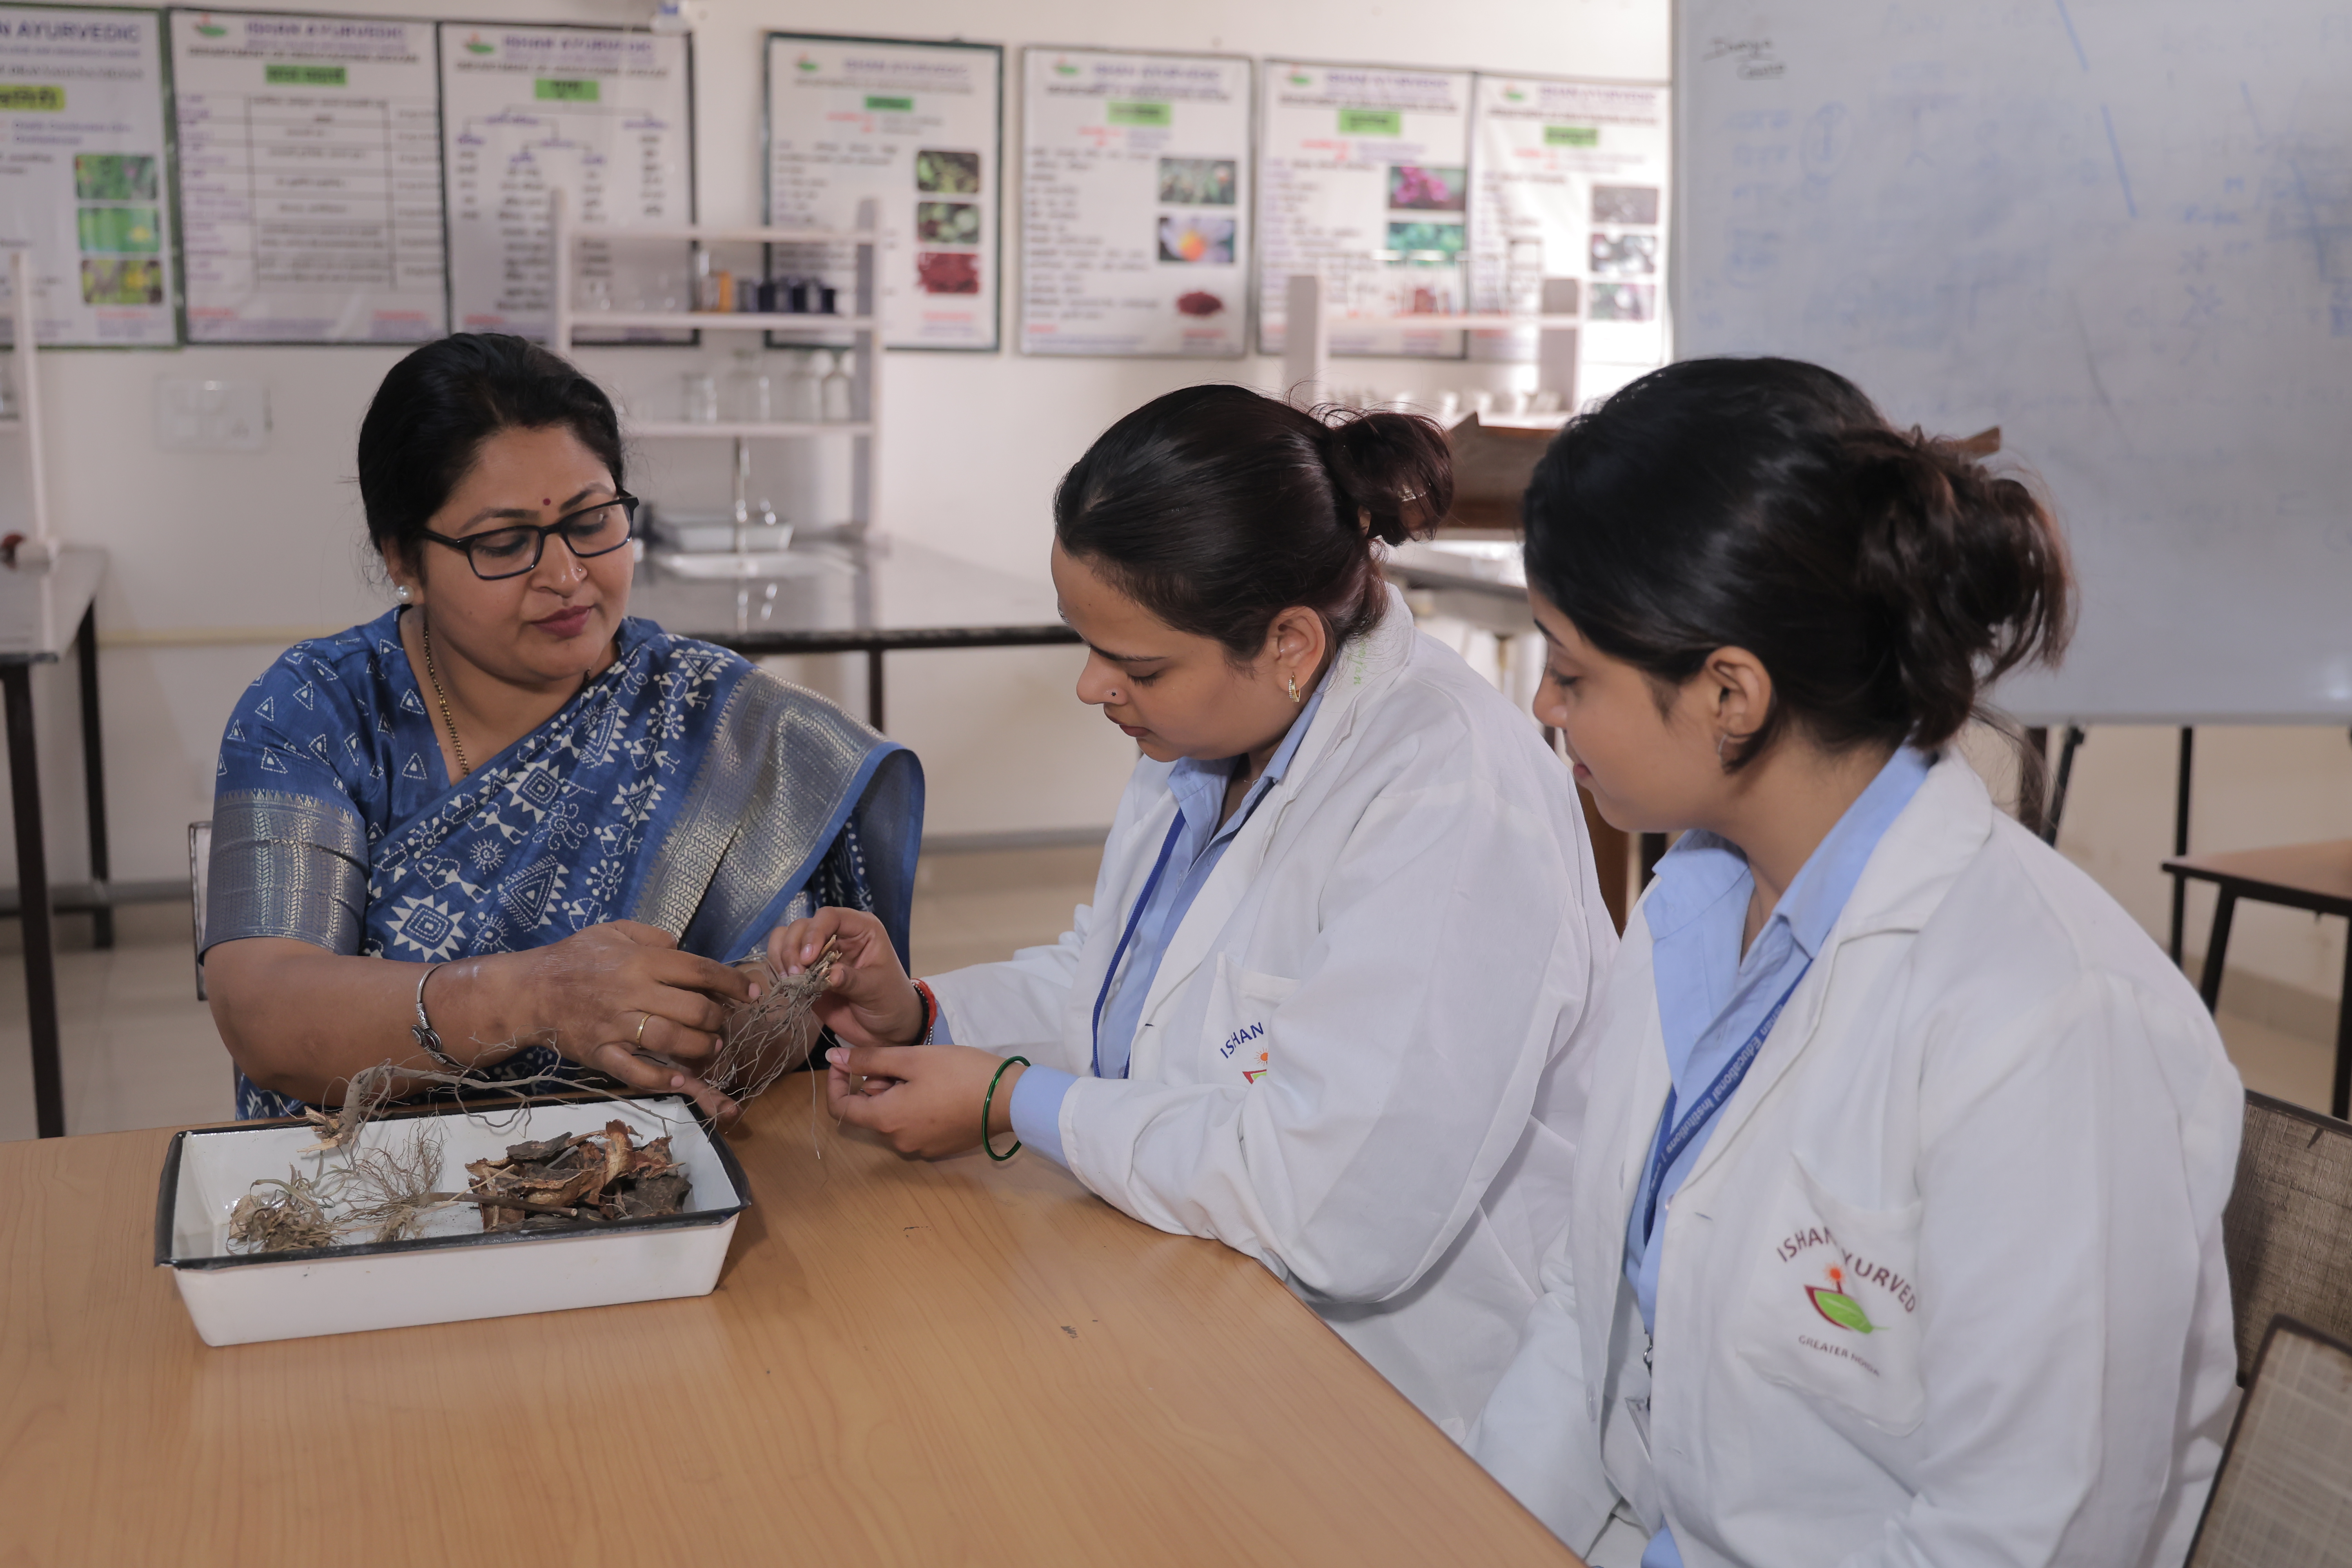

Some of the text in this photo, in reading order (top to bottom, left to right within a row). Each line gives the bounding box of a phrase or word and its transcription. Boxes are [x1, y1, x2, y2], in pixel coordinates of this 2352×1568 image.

[1220, 1022, 1264, 1059] ISHAN
[1712, 1036, 1763, 1101] Educational
[1666, 1097, 1715, 1154] Institutions
[1841, 1248, 1916, 1313] YURVED
[1798, 1334, 1848, 1358] GREATER
